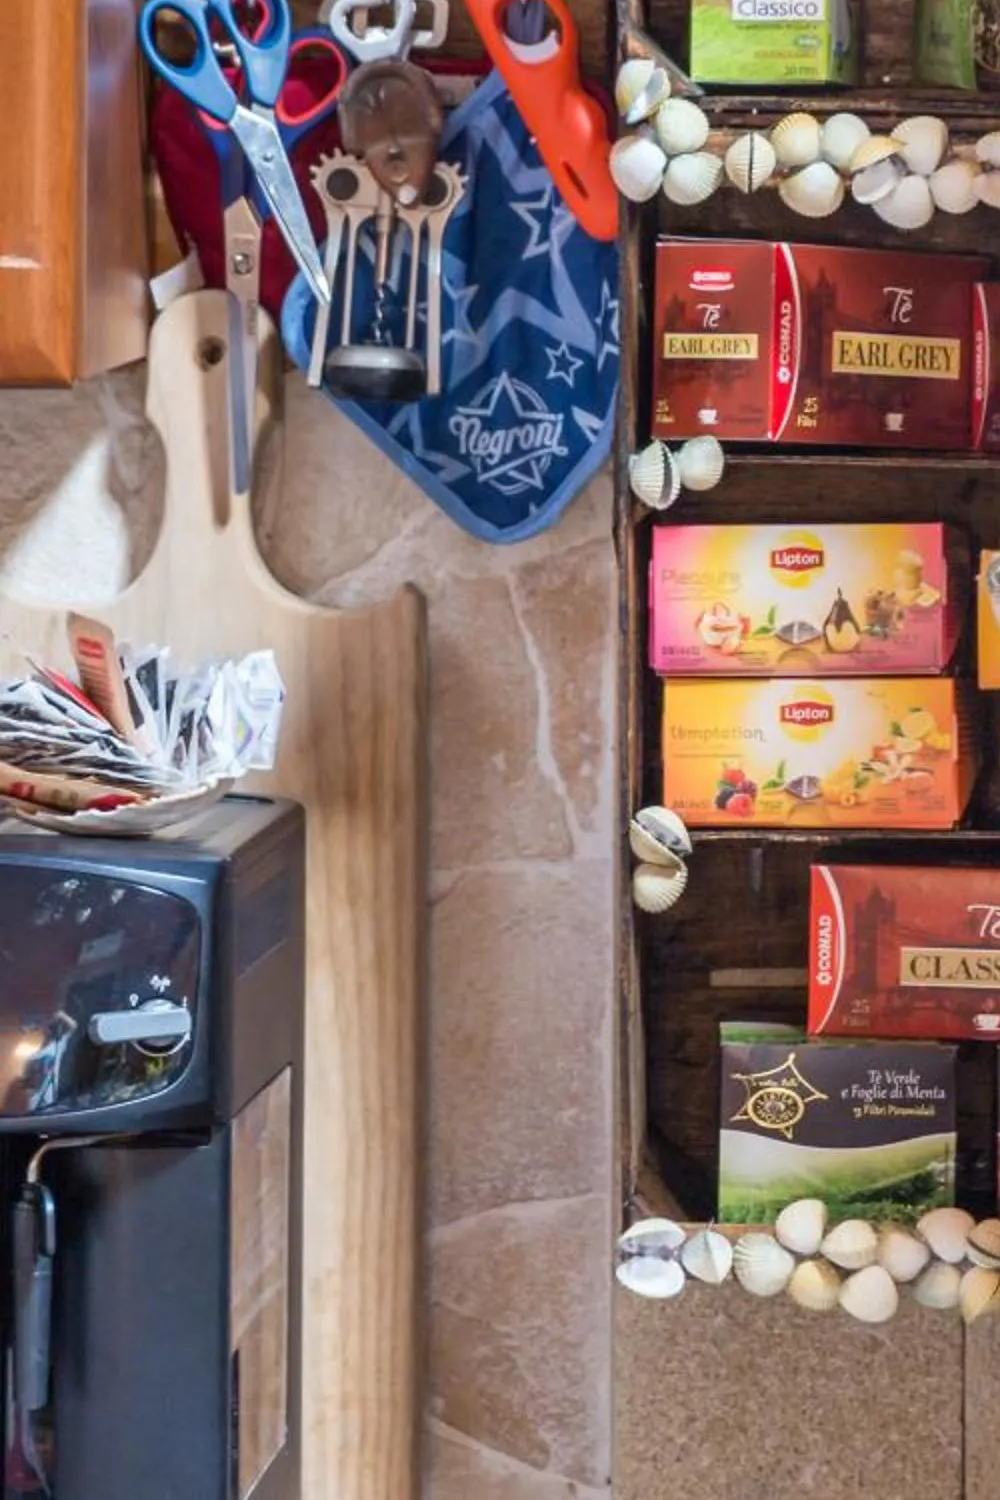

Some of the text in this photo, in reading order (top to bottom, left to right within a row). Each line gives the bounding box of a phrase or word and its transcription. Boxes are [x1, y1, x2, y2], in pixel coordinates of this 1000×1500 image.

[737, 0, 818, 17] Classico
[668, 337, 753, 355] EARL GREY
[839, 338, 955, 374] EARL GREY
[449, 413, 568, 463] Negroni
[775, 551, 821, 569] Lipton
[784, 707, 831, 724] Lipton
[818, 914, 833, 971] CONAD
[885, 1068, 921, 1086] Verde
[851, 1083, 887, 1103] Foglie
[889, 1084, 903, 1100] di
[906, 1085, 946, 1100] Menta
